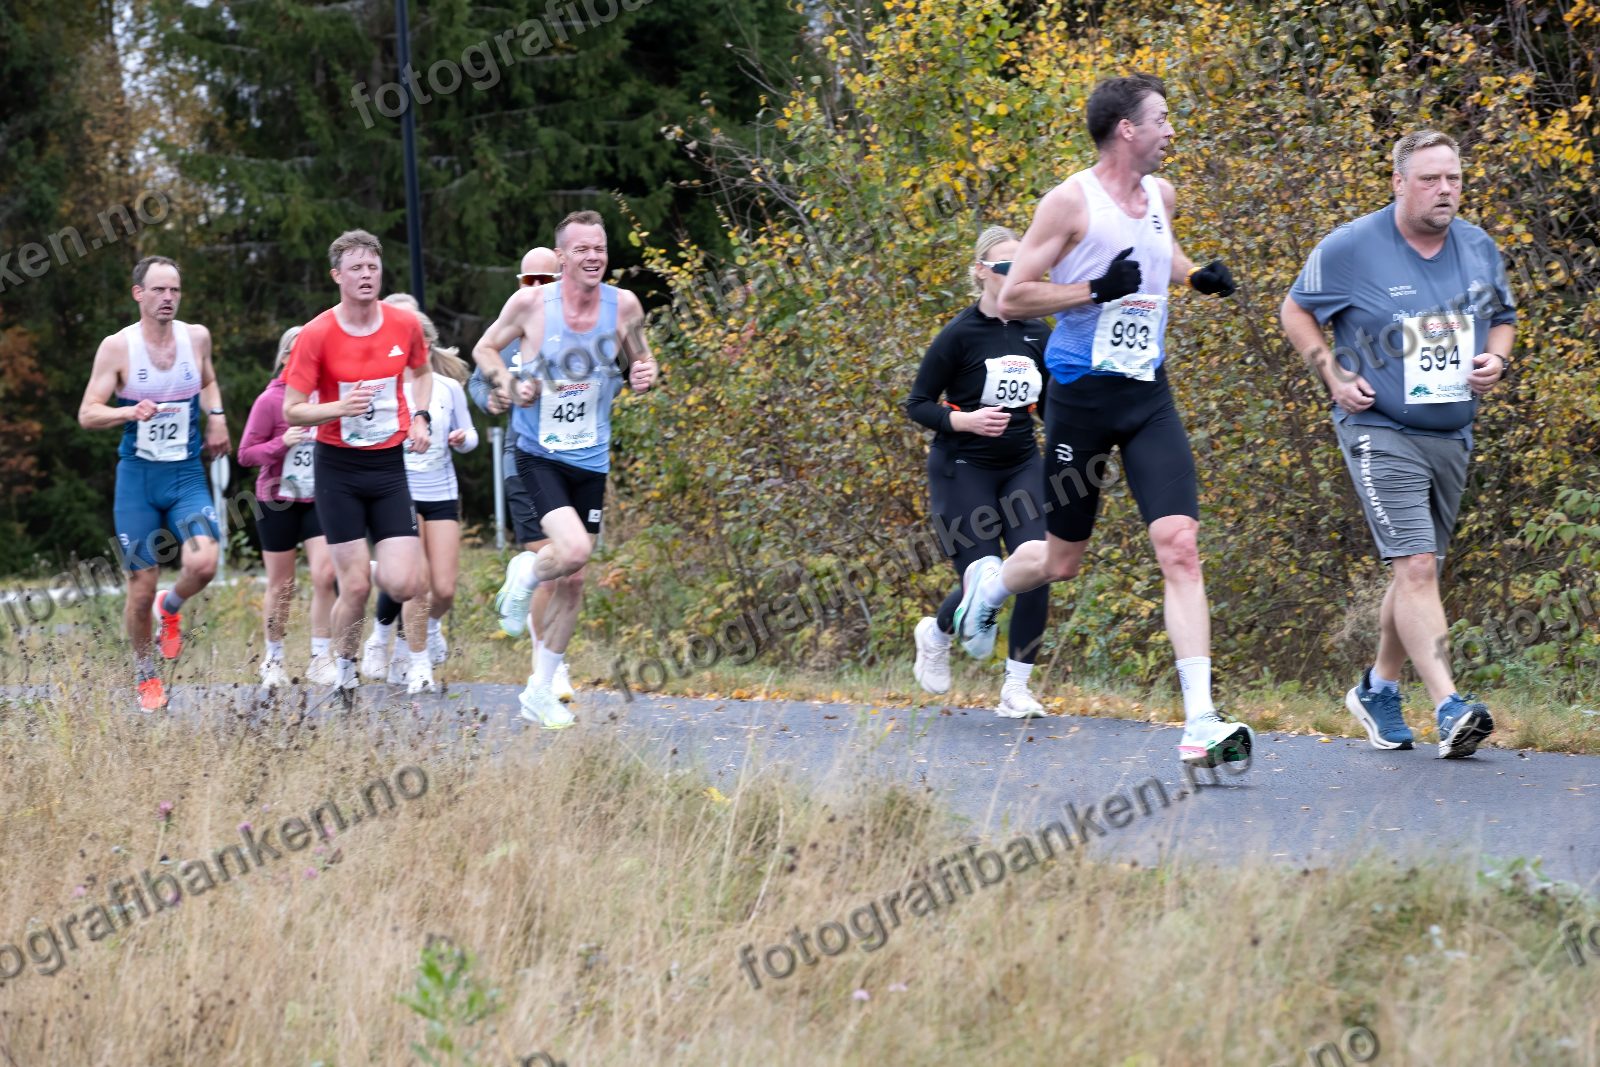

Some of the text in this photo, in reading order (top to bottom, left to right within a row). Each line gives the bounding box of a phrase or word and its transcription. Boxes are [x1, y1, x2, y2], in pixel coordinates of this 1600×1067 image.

[1111, 321, 1150, 351] 993
[1419, 345, 1461, 371] 594
[996, 380, 1029, 402] 593
[552, 402, 586, 422] 484
[149, 423, 178, 442] 512
